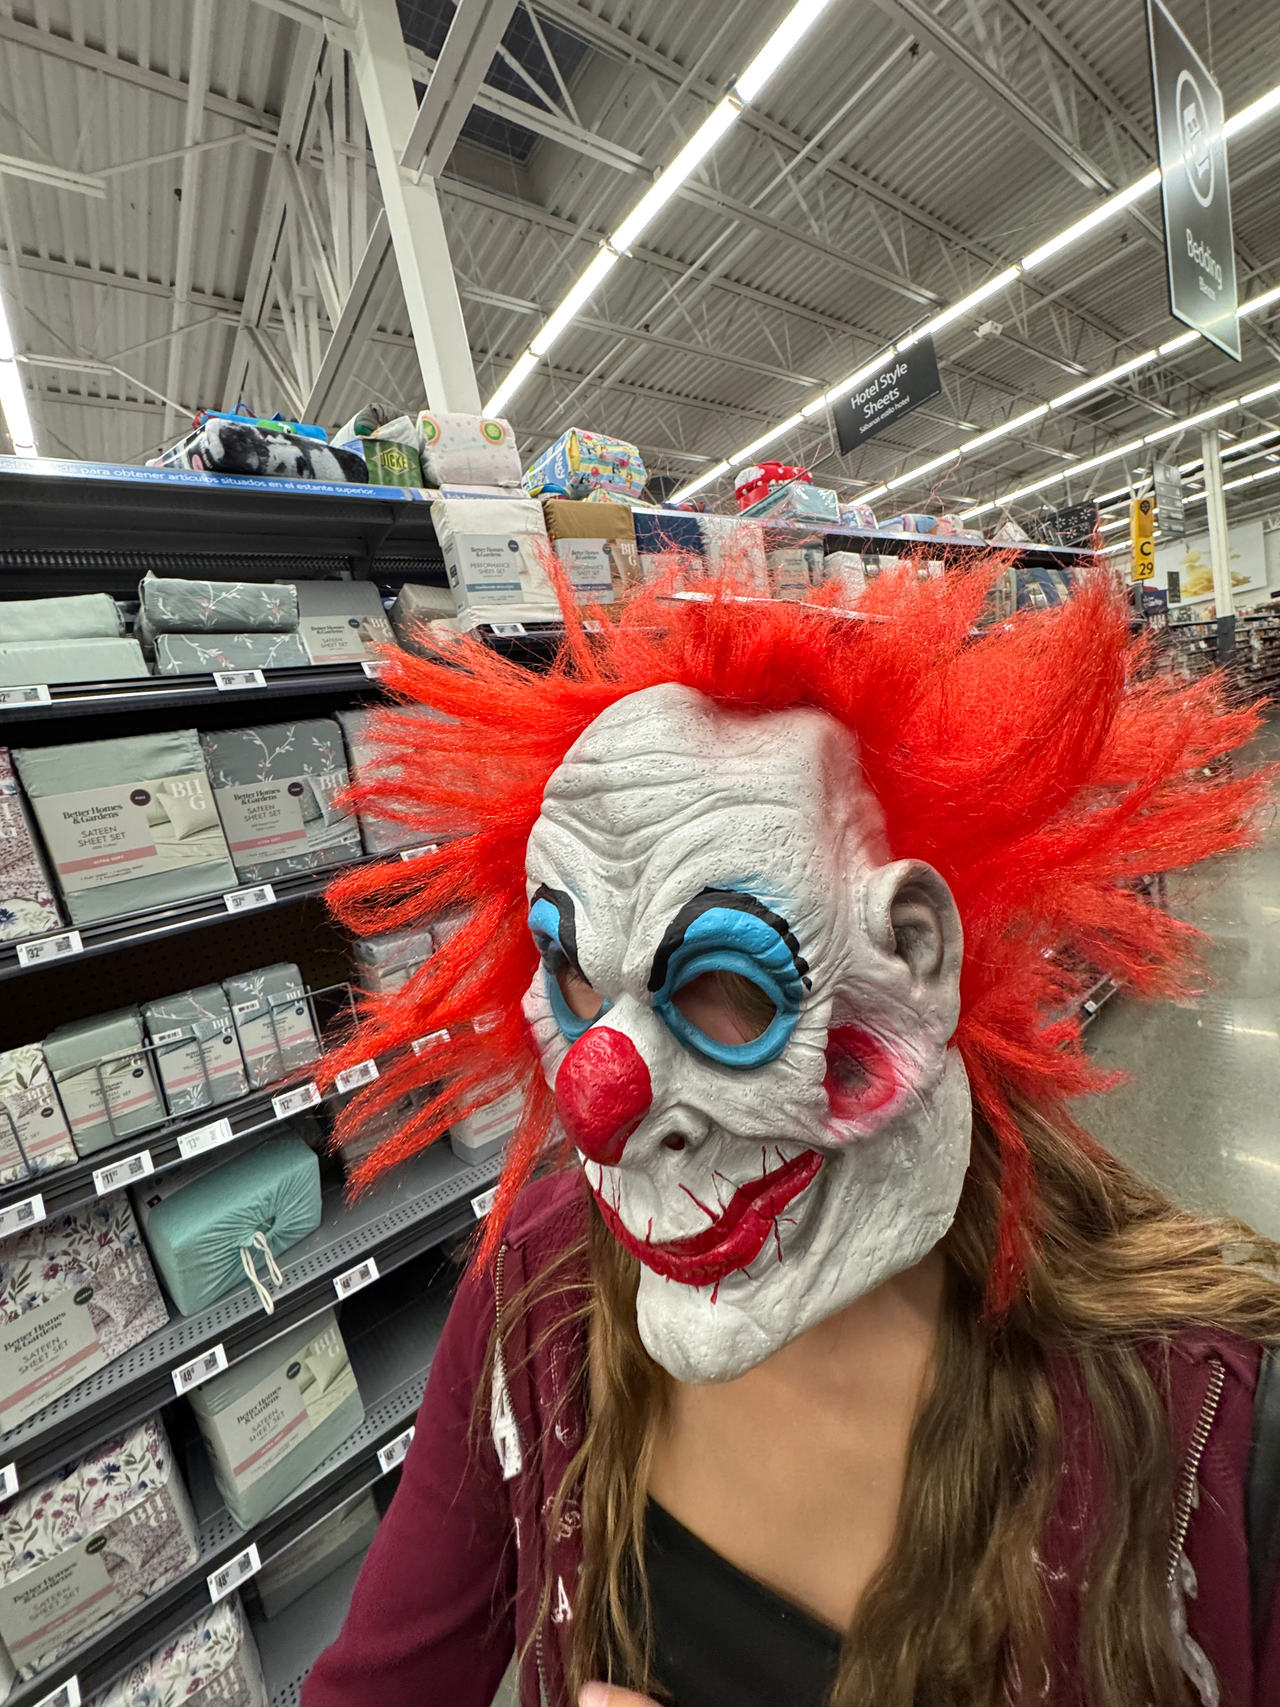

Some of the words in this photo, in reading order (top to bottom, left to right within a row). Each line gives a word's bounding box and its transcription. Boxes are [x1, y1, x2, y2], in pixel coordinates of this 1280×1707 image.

[1186, 228, 1222, 290] Bedding
[850, 379, 879, 409] Hotel
[880, 363, 908, 389] Style
[863, 387, 900, 419] Sheets
[80, 467, 110, 477] para
[113, 469, 164, 480] obtener
[220, 476, 266, 487] situados
[296, 483, 334, 492] estante
[1140, 541, 1152, 556] C
[1139, 562, 1154, 576] 29
[62, 810, 90, 820] Better
[91, 805, 124, 815] Homes
[244, 812, 266, 822] SHEET
[247, 804, 276, 814] SATEEN
[77, 835, 106, 848] SHEET
[109, 832, 126, 841] SET
[81, 826, 117, 839] SATEEN
[4, 1332, 32, 1352] Better
[33, 1312, 66, 1333] Homes
[18, 1352, 49, 1375] SHEET
[52, 1339, 68, 1354] SET
[22, 1336, 60, 1363] SATEEN
